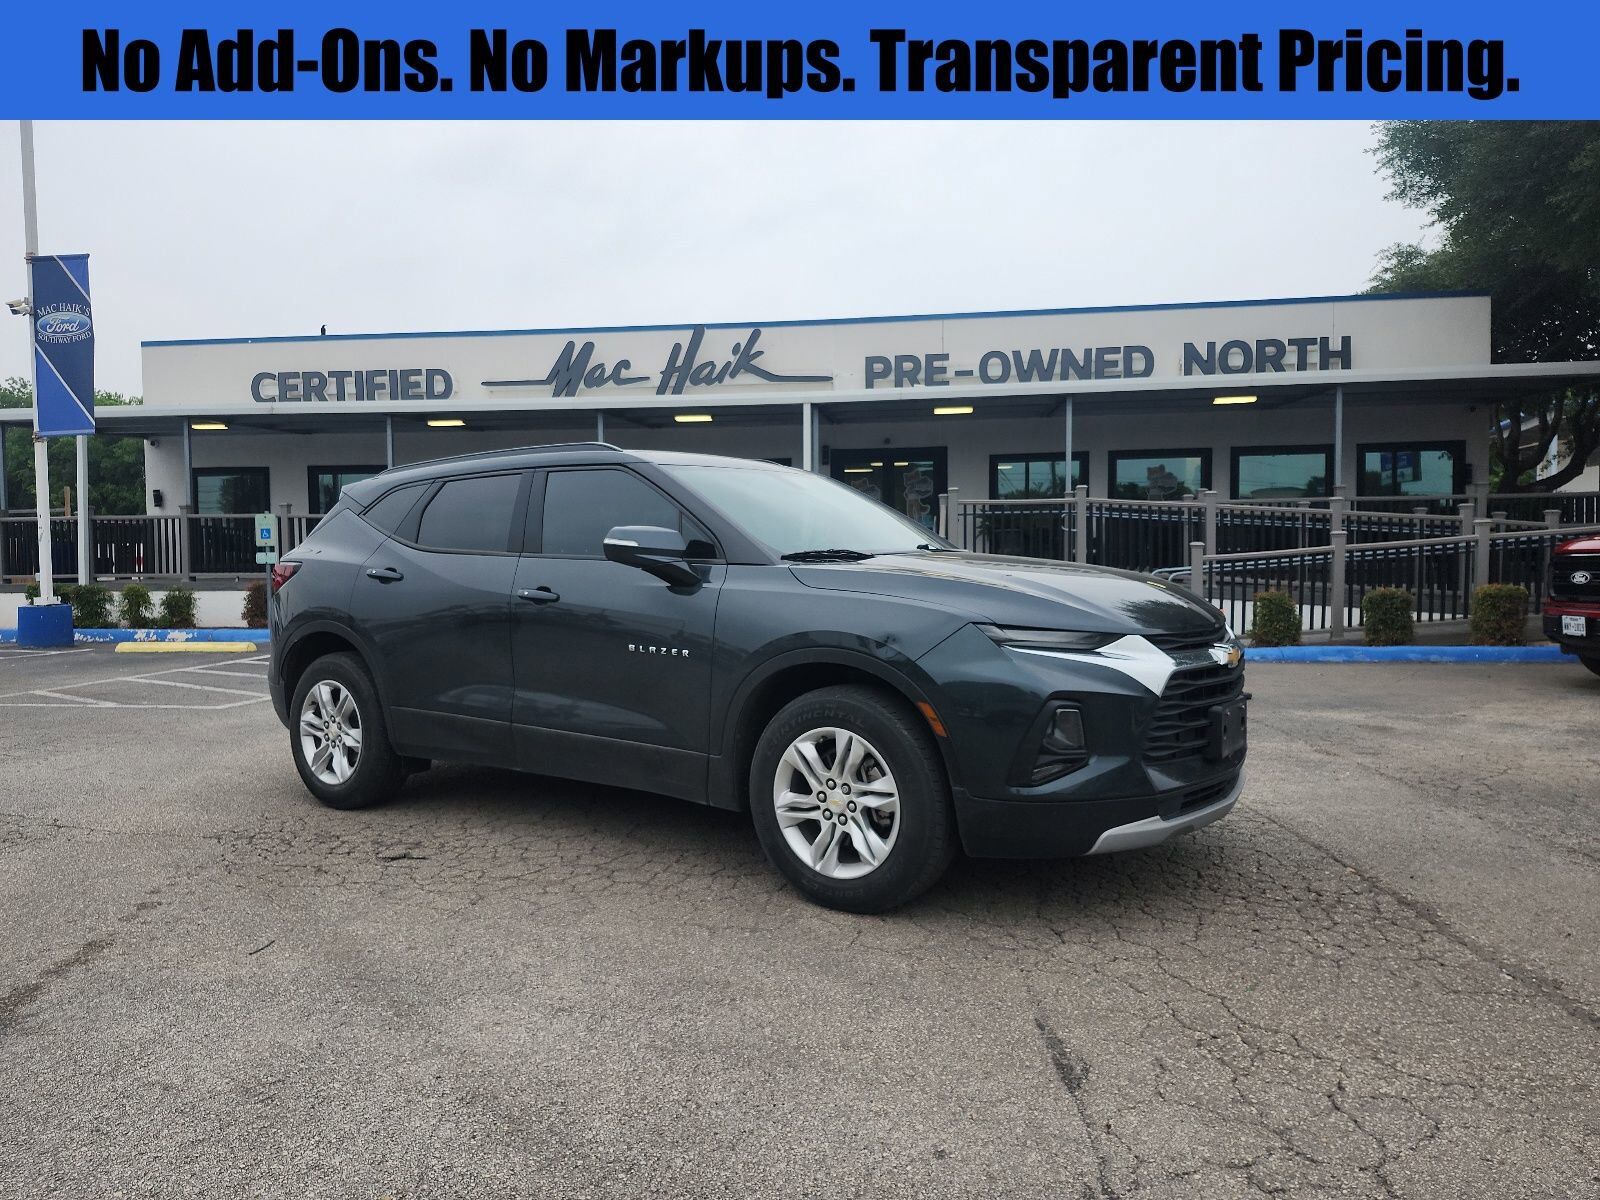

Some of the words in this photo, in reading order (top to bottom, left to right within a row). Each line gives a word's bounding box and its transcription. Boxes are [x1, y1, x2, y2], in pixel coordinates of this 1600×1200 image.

[37, 303, 57, 317] MAC
[59, 303, 91, 317] HAIK'S
[46, 317, 80, 333] Ford
[72, 331, 92, 342] FORD
[251, 368, 455, 402] CERTIFIED
[482, 340, 650, 398] Mac
[656, 325, 834, 396] Haik
[864, 344, 1155, 390] PRE-OWNED
[1183, 335, 1353, 377] NORTH
[628, 644, 690, 658] BLAZER
